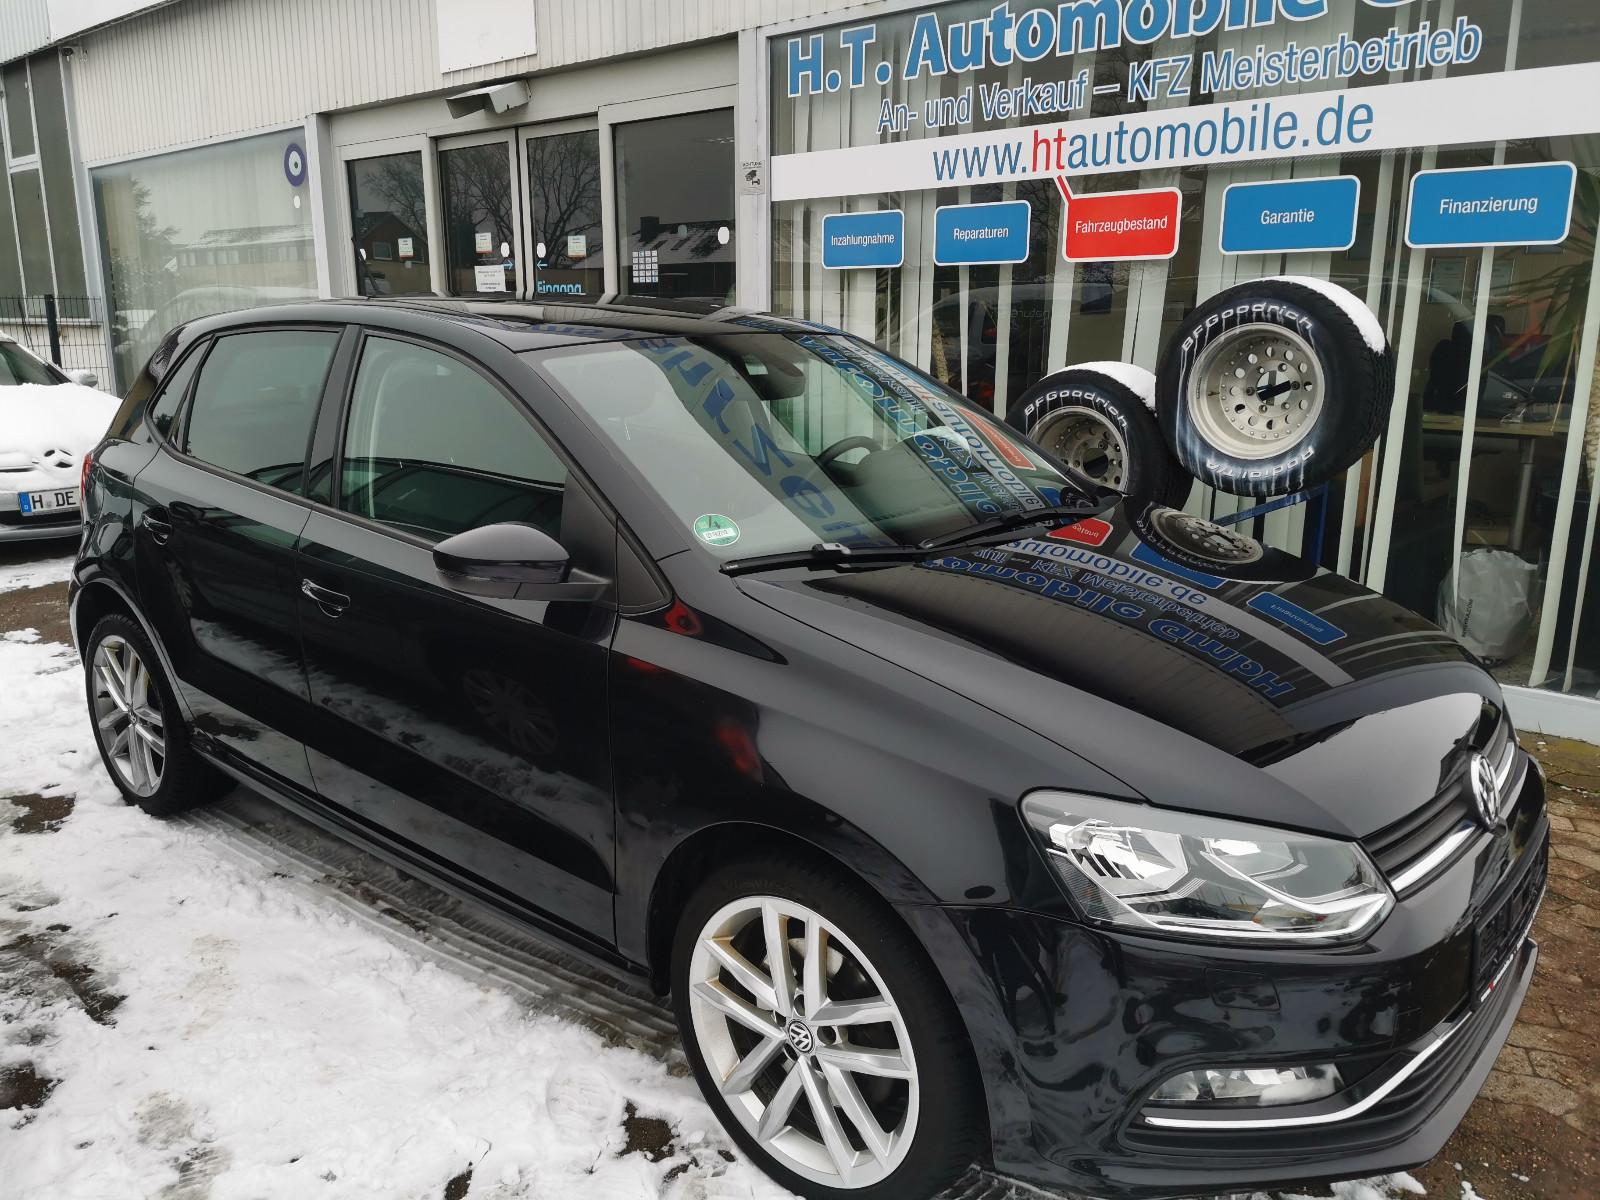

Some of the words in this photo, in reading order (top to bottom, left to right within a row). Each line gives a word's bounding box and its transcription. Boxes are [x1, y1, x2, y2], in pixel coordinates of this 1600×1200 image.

[787, 24, 892, 98] H.T.
[876, 98, 917, 134] An-
[924, 87, 973, 128] und
[979, 69, 1089, 121] Verkauf
[1127, 54, 1194, 103] KFZ
[1200, 15, 1483, 94] Meisterbetrieb
[933, 94, 1374, 181] www.htautomobile.de
[1439, 197, 1538, 215] Finanzierung
[1075, 215, 1168, 236] Fahrzeugbestand
[1260, 208, 1315, 225] Garantie
[831, 232, 895, 247] Inzahlungnahme
[953, 226, 1009, 242] Reparaturen
[31, 494, 43, 509] H
[54, 491, 77, 507] DE
